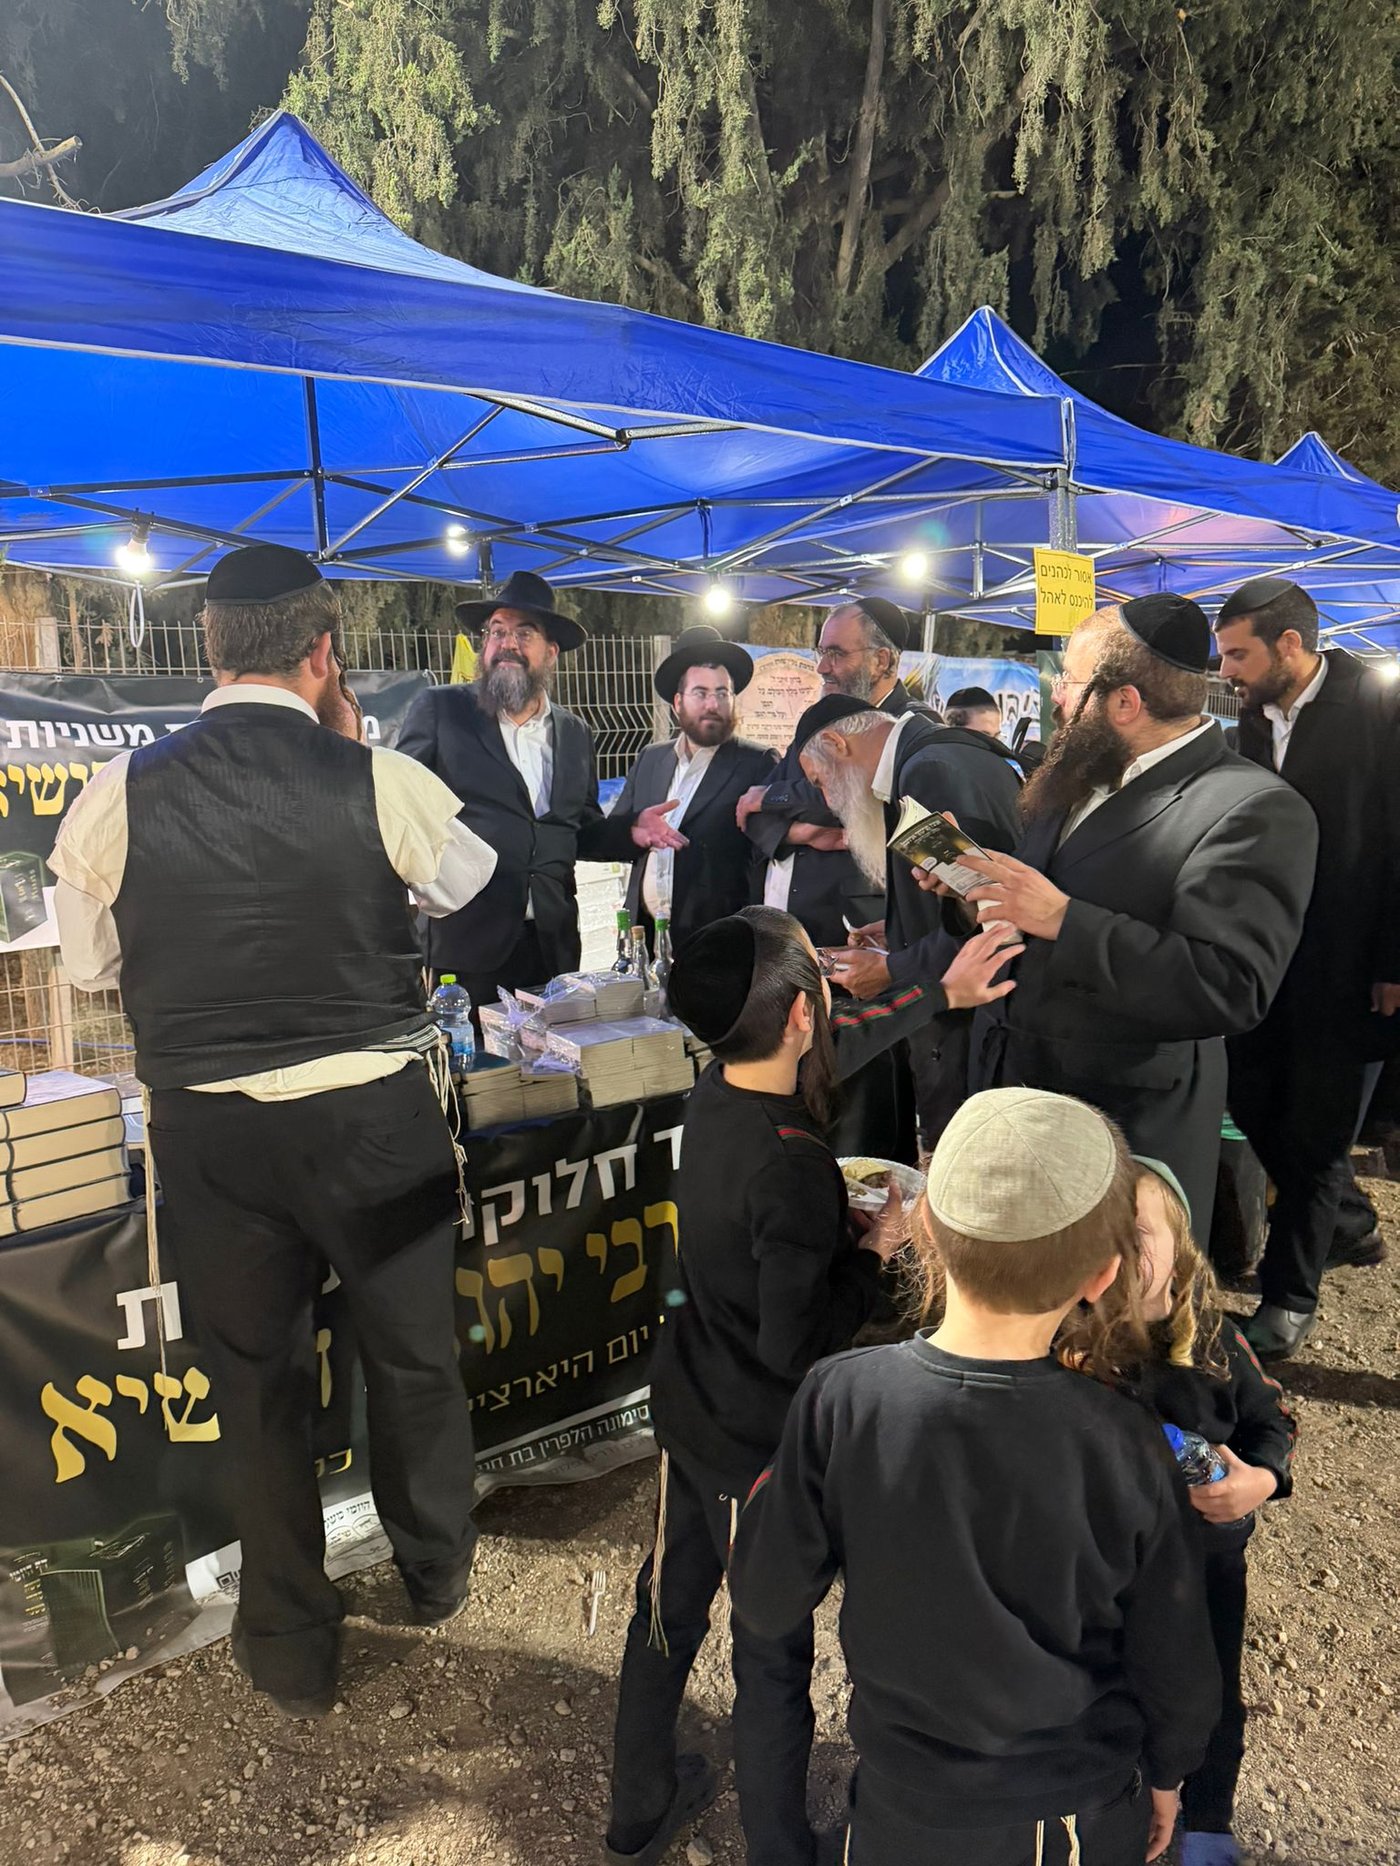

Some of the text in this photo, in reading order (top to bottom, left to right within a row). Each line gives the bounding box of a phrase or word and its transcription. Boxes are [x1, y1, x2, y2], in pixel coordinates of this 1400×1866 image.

[1073, 569, 1092, 584] אסור
[1040, 587, 1067, 605] לאהל
[6, 720, 155, 749] משניות
[462, 1143, 638, 1246] חלוק
[455, 1200, 679, 1355] רבי יהו
[468, 1325, 648, 1412] יום היארציי
[41, 1366, 220, 1483] שיא
[598, 1404, 649, 1435] סימונה
[509, 1447, 536, 1466] בת
[539, 1426, 592, 1459] הלפרין
